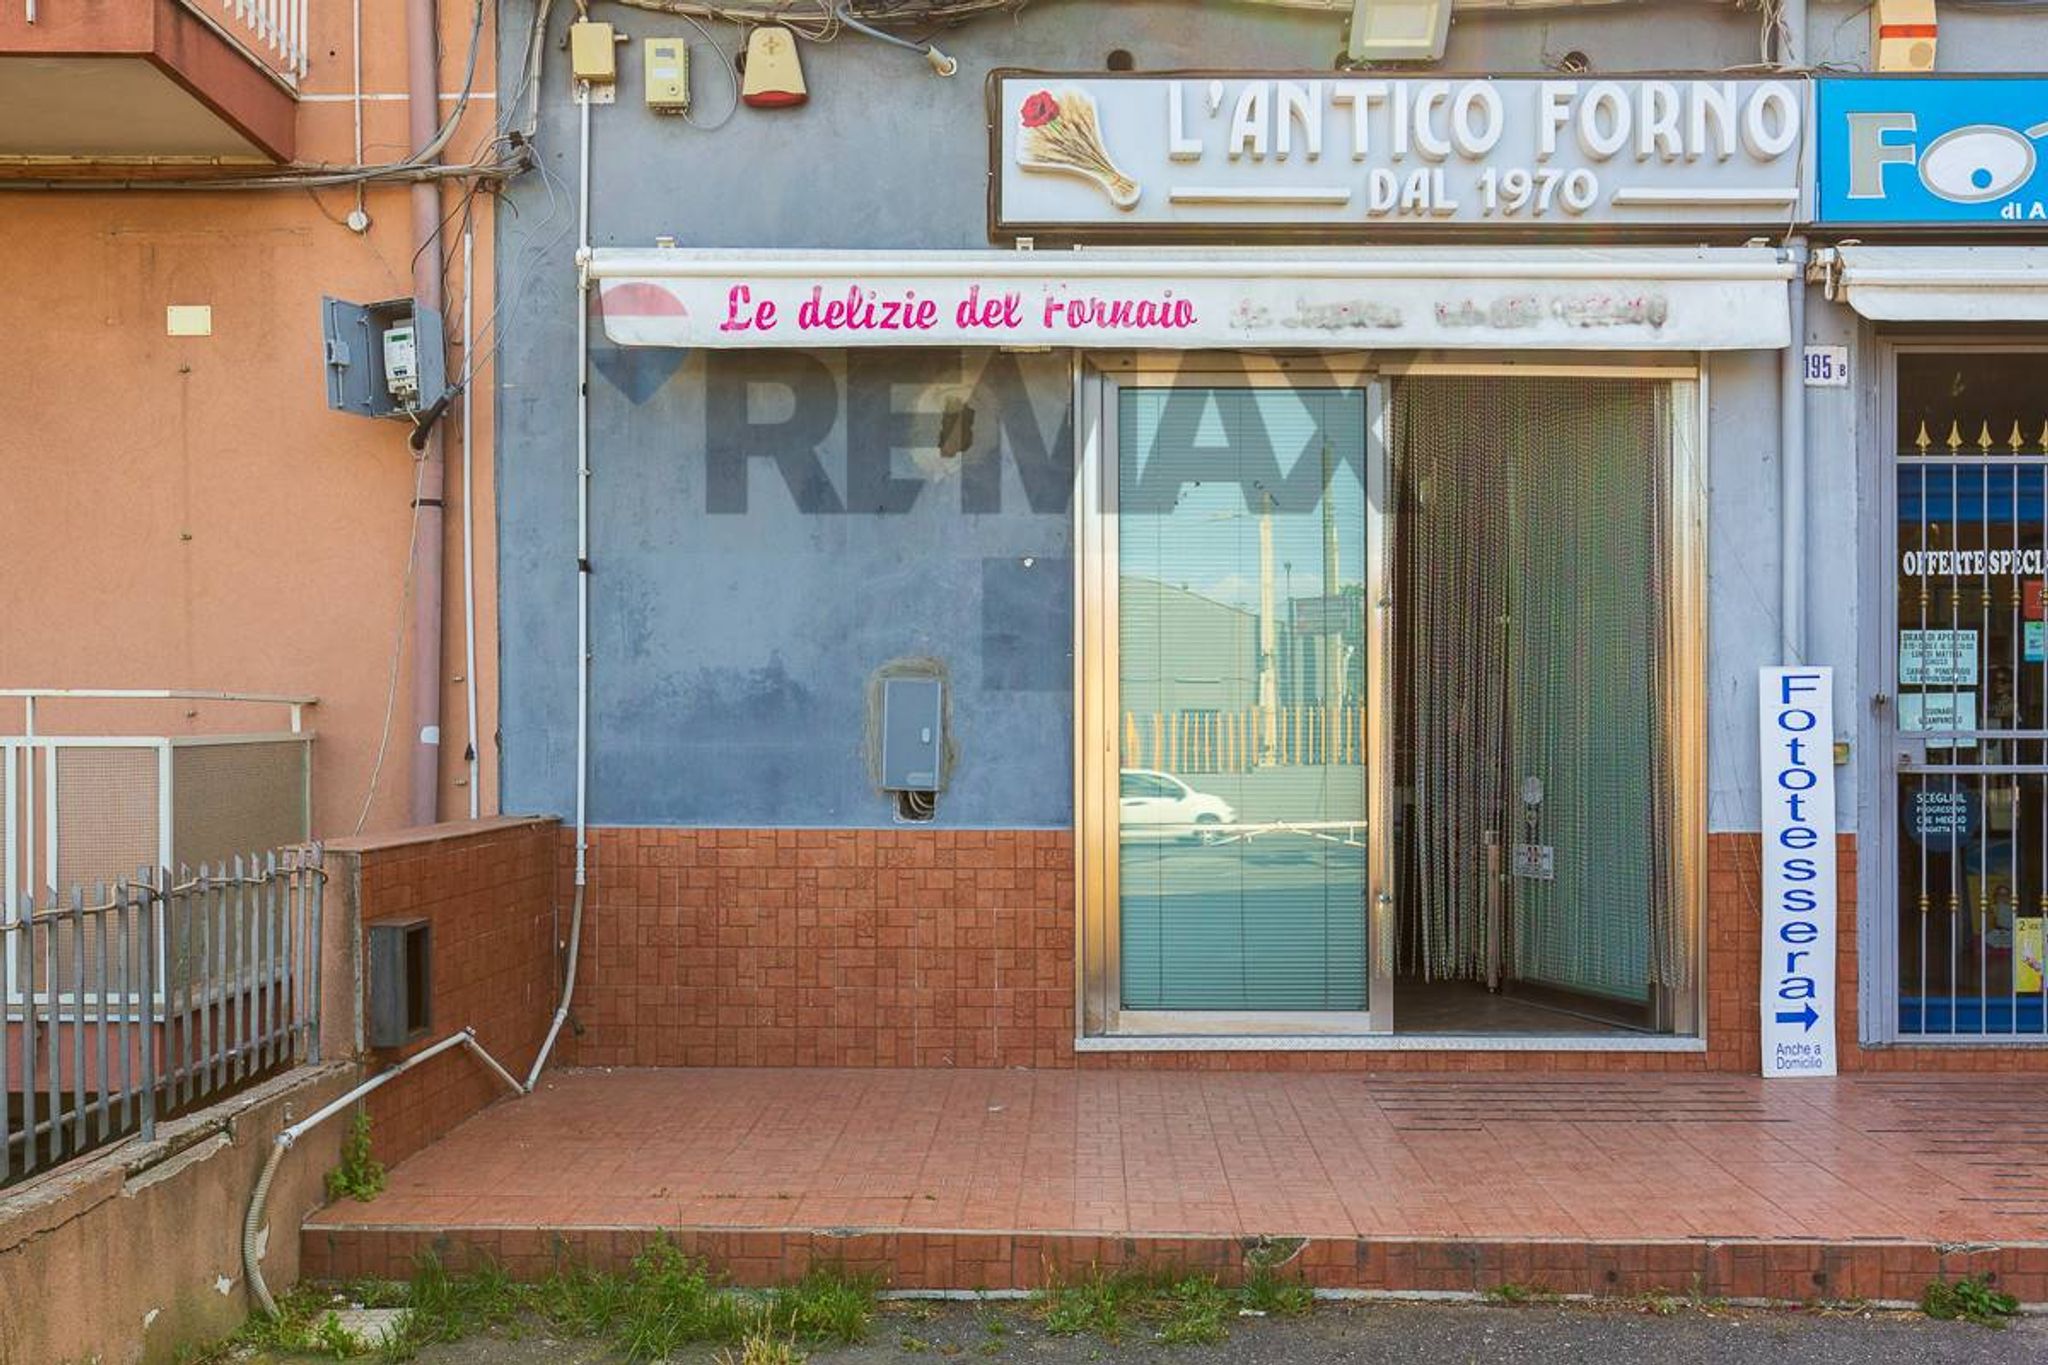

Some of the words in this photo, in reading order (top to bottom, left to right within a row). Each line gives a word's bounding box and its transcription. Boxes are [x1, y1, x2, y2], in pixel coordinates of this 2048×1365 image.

[1168, 80, 1502, 161] L'ANTICO
[1536, 80, 1800, 161] FORNO
[1366, 168, 1458, 216] DAL
[1477, 168, 1598, 217] 1970
[2001, 202, 2022, 219] di
[720, 285, 777, 331] Le
[799, 285, 938, 330] delizie
[956, 285, 1023, 330] del
[1043, 285, 1198, 330] Fornaio
[1804, 354, 1831, 379] 195
[1840, 364, 1846, 377] B
[1903, 551, 1985, 576] OFFERTE
[1989, 550, 2048, 575] SPECI
[1916, 805, 1967, 814] POGRESSVO
[1778, 675, 1820, 999] Fototessera
[1776, 1043, 1811, 1056] Anche
[1814, 1044, 1821, 1055] a
[1776, 1056, 1823, 1070] Domicilio
